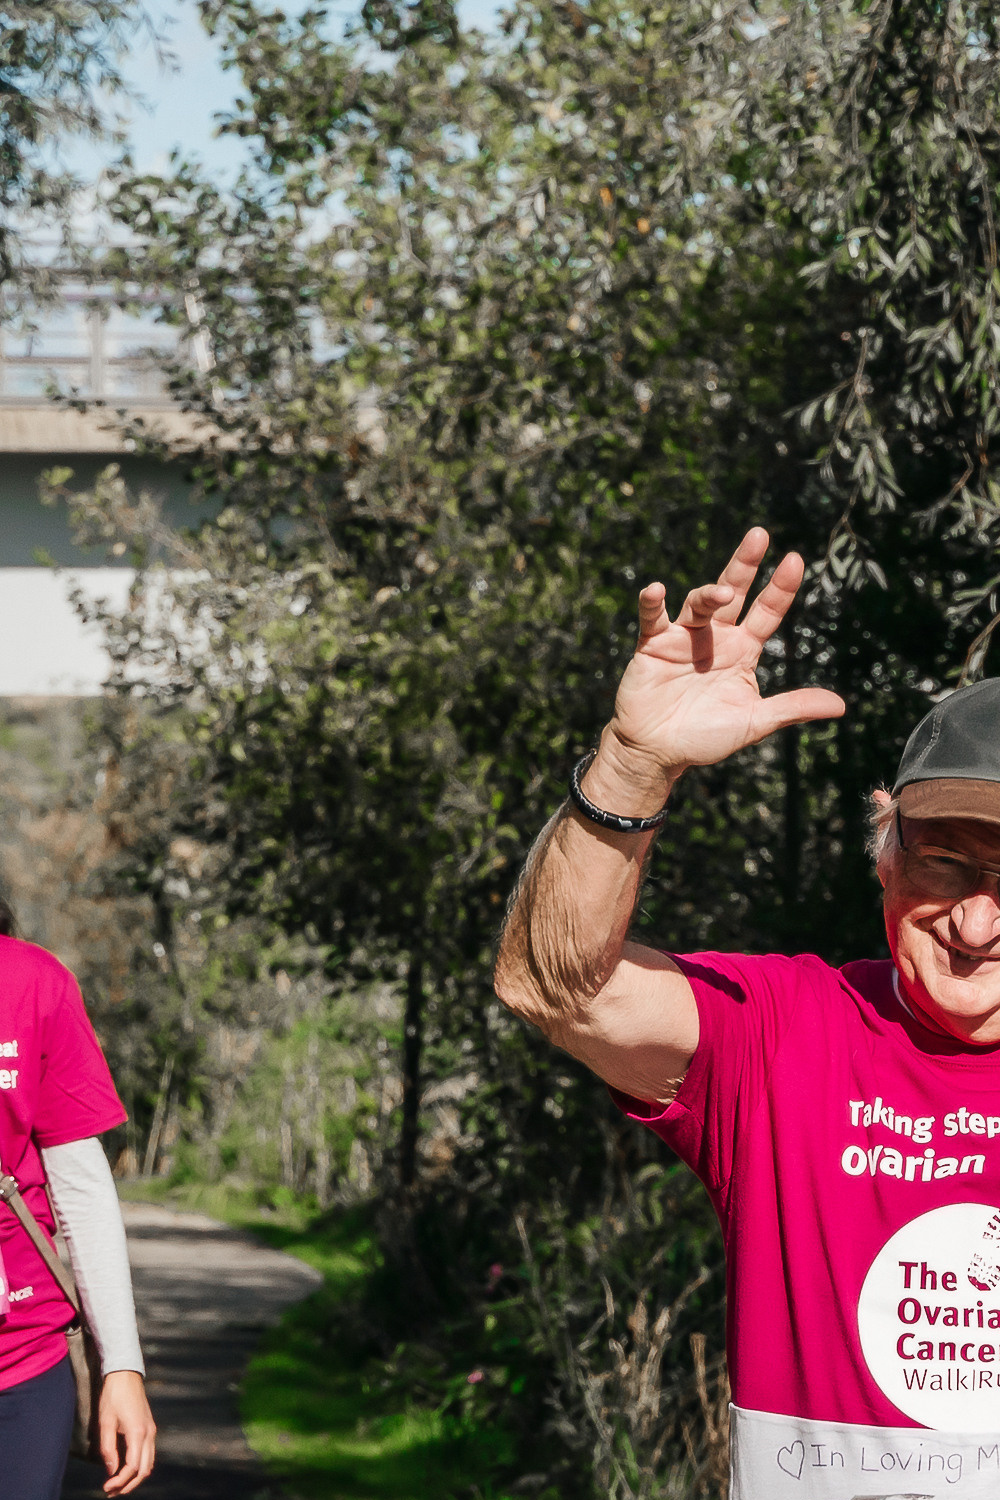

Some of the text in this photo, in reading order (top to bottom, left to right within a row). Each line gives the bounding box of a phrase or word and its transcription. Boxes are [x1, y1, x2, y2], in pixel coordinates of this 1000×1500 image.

[849, 1097, 935, 1143] Taking
[841, 1145, 986, 1182] Ovarian
[899, 1261, 958, 1291] The
[811, 1444, 844, 1468] In
[861, 1443, 963, 1484] Loving
